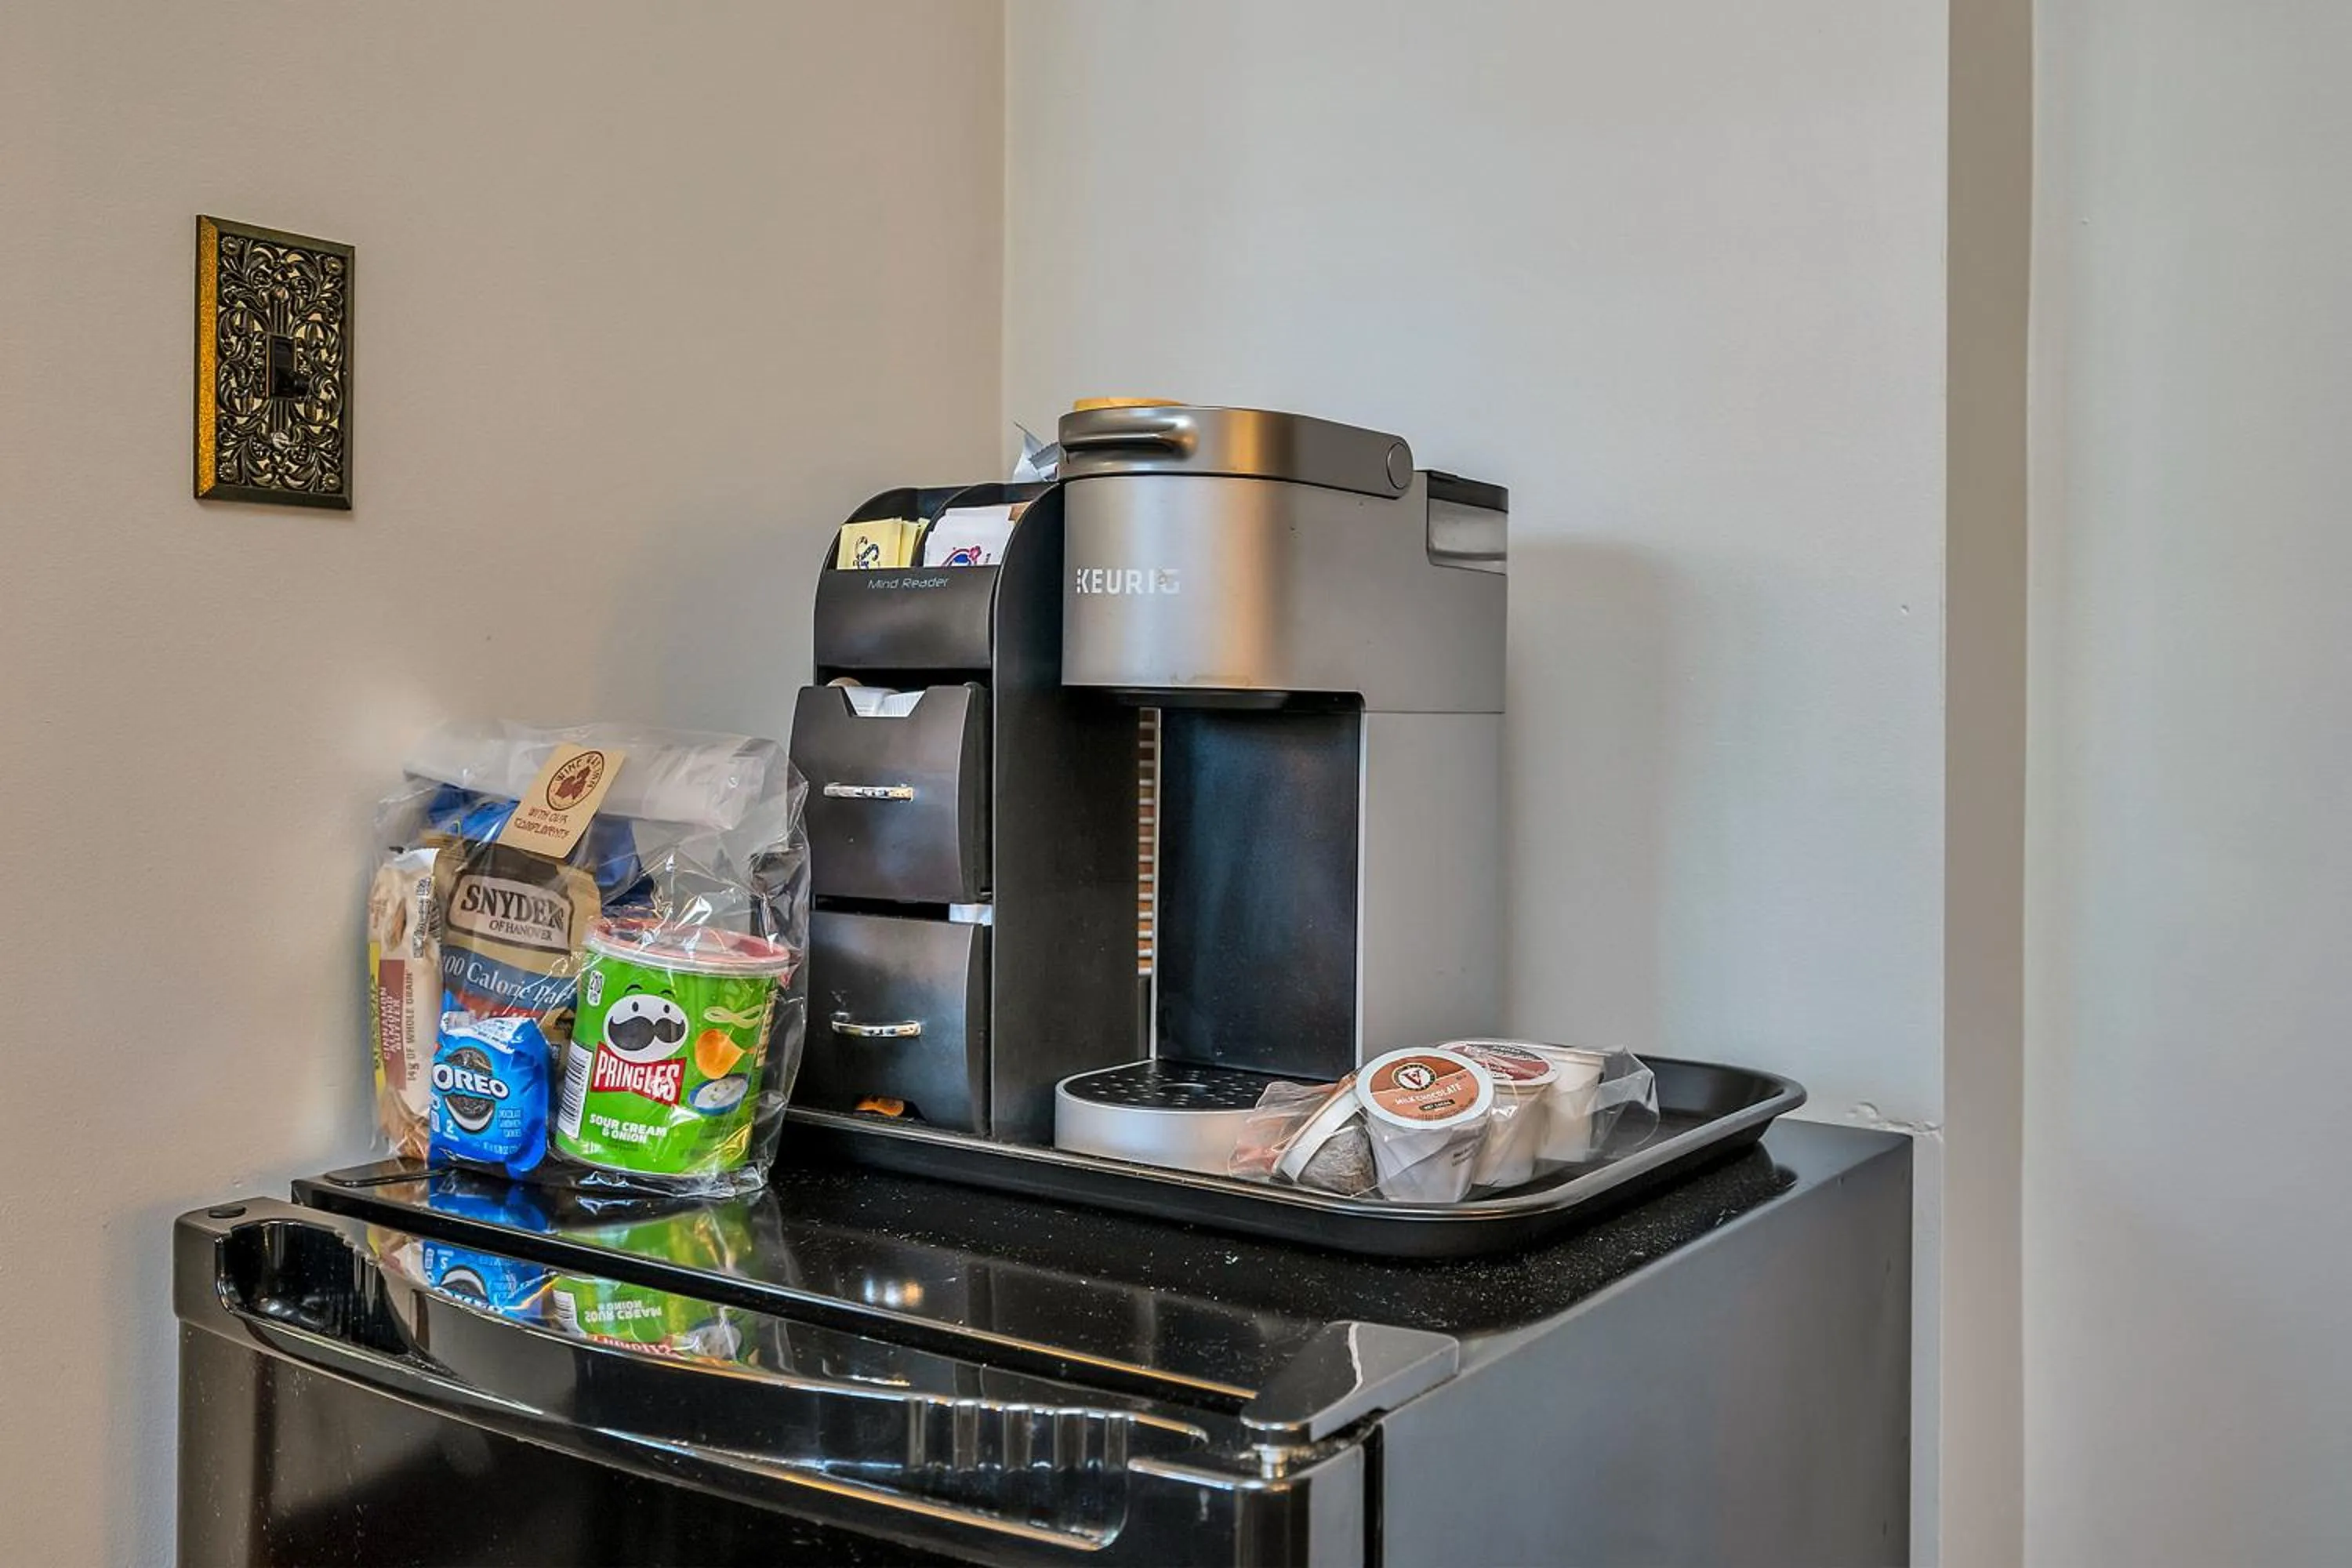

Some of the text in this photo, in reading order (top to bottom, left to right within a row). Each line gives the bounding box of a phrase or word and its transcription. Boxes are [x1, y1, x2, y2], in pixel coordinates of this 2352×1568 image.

[868, 577, 949, 589] Mind Reader
[1076, 568, 1180, 594] KEURIG
[489, 920, 506, 934] OF
[444, 954, 465, 976] 00
[432, 1063, 509, 1098] OREO
[594, 1050, 680, 1102] PRINGLES
[590, 1113, 667, 1137] SOUR CREAM
[611, 1131, 648, 1145] ONION
